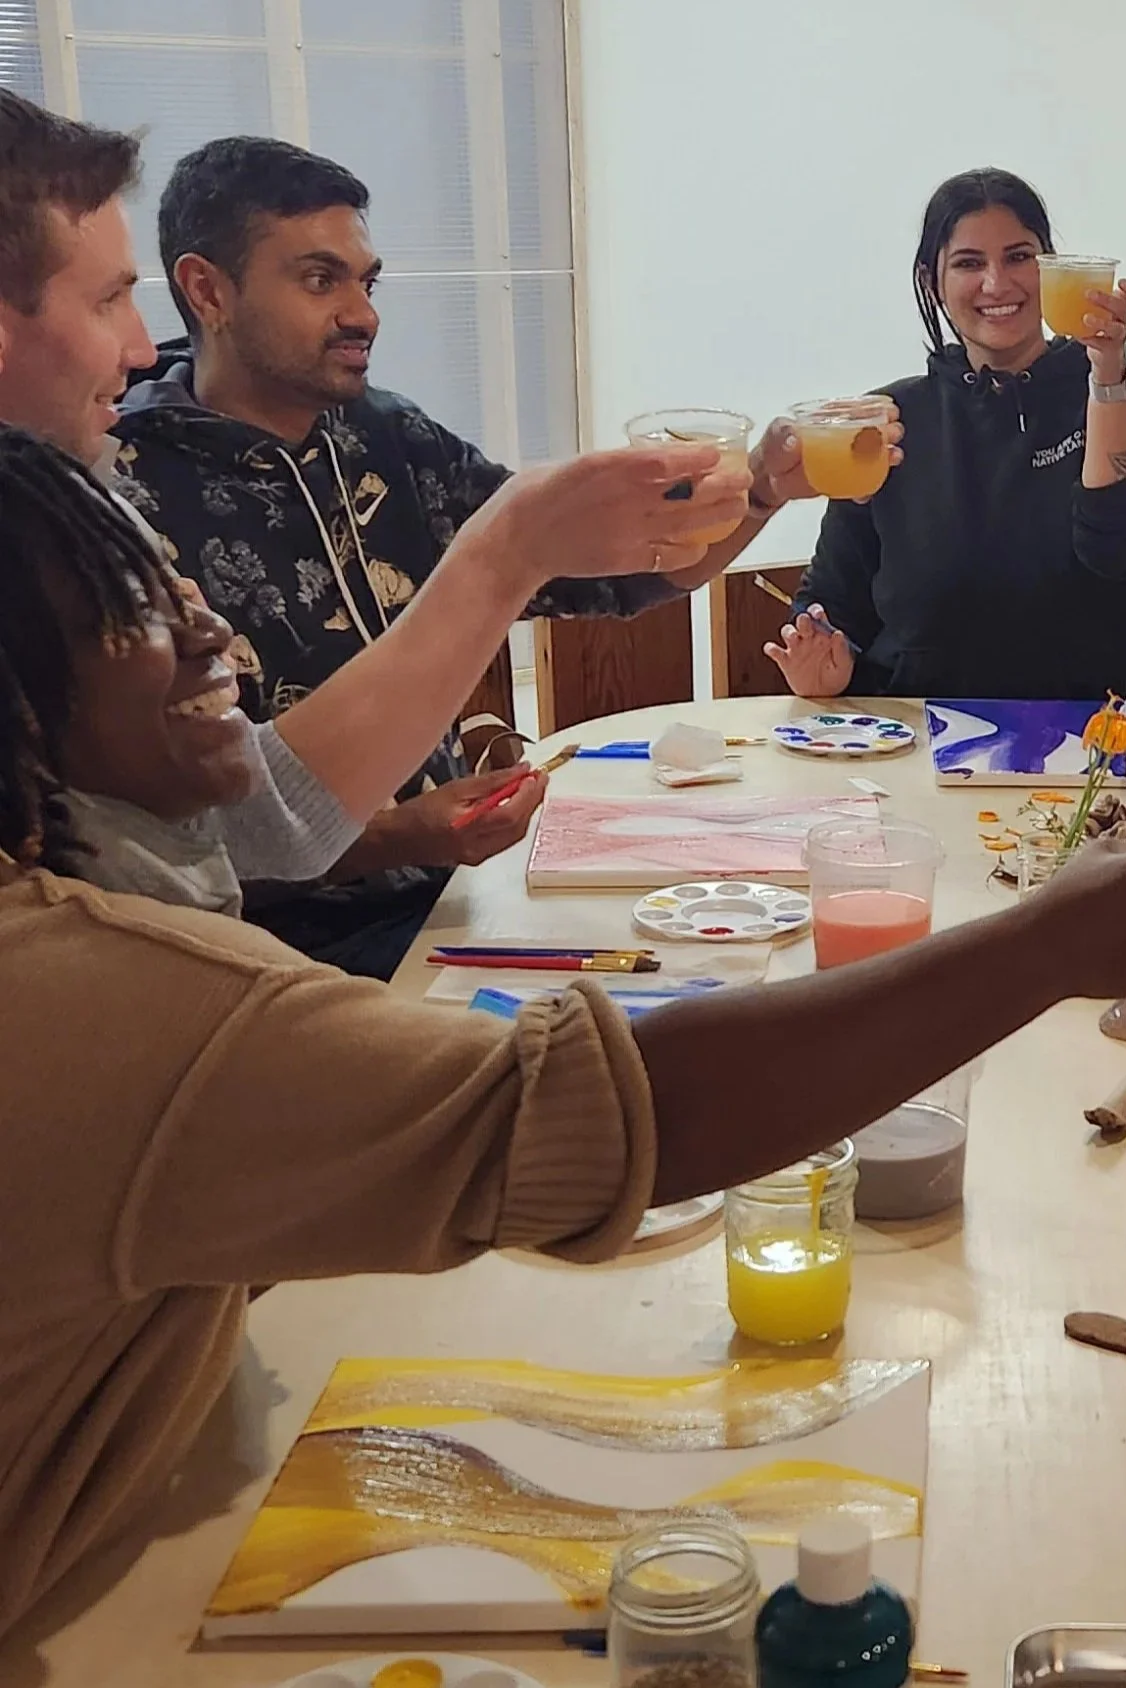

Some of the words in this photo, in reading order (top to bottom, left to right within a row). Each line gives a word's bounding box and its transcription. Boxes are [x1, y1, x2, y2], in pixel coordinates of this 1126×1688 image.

[1032, 449, 1066, 468] NATIVE
[1066, 439, 1085, 453] LAN
[1035, 447, 1055, 458] YOU
[1057, 436, 1073, 452] ARE
